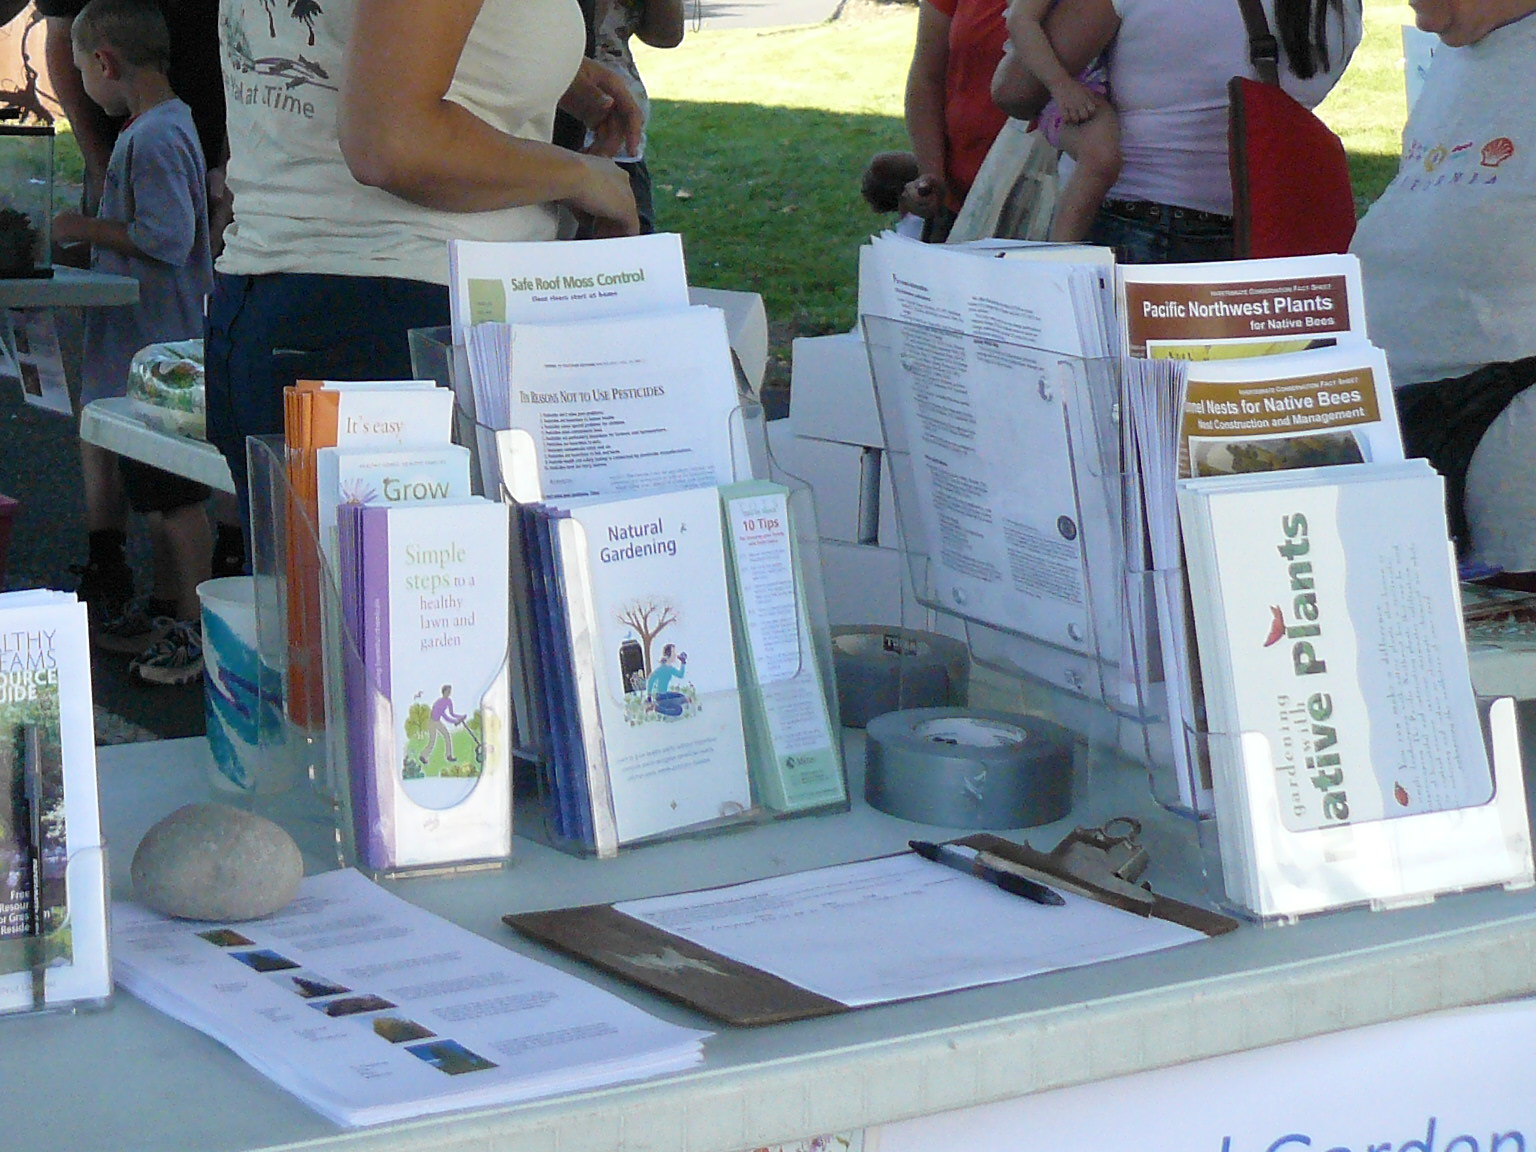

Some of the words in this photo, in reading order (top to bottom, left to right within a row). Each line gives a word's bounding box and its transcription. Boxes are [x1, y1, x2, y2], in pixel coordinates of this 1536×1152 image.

[265, 85, 315, 119] Time
[511, 279, 533, 291] Safe
[535, 276, 560, 290] Roof
[563, 277, 594, 289] Moss
[597, 268, 645, 286] Control
[1142, 300, 1186, 319] Pacific
[1188, 299, 1270, 317] Northwest
[1273, 295, 1333, 315] Plants
[1250, 319, 1264, 331] for
[1267, 318, 1302, 330] Native
[1305, 316, 1335, 328] Bees
[611, 385, 665, 400] PESTICIDES
[1206, 398, 1239, 415] Nests
[1241, 399, 1260, 414] for
[1263, 395, 1314, 412] Native
[1317, 389, 1362, 407] Bees
[373, 419, 404, 439] easy
[1214, 418, 1270, 430] Construction
[1271, 416, 1291, 428] and
[1292, 407, 1366, 426] Management
[383, 477, 450, 502] Grow
[607, 517, 664, 542] Natural
[743, 519, 755, 531] 10
[757, 518, 780, 531] Tips
[404, 541, 466, 569] Simple
[600, 538, 677, 564] Gardening
[405, 573, 451, 596] steps
[454, 575, 465, 587] to
[468, 577, 475, 587] a
[420, 595, 464, 611] healthy
[420, 615, 450, 630] lawn
[452, 613, 476, 628] and
[420, 634, 461, 652] garden
[1290, 700, 1312, 753] with
[1275, 693, 1306, 818] gardening
